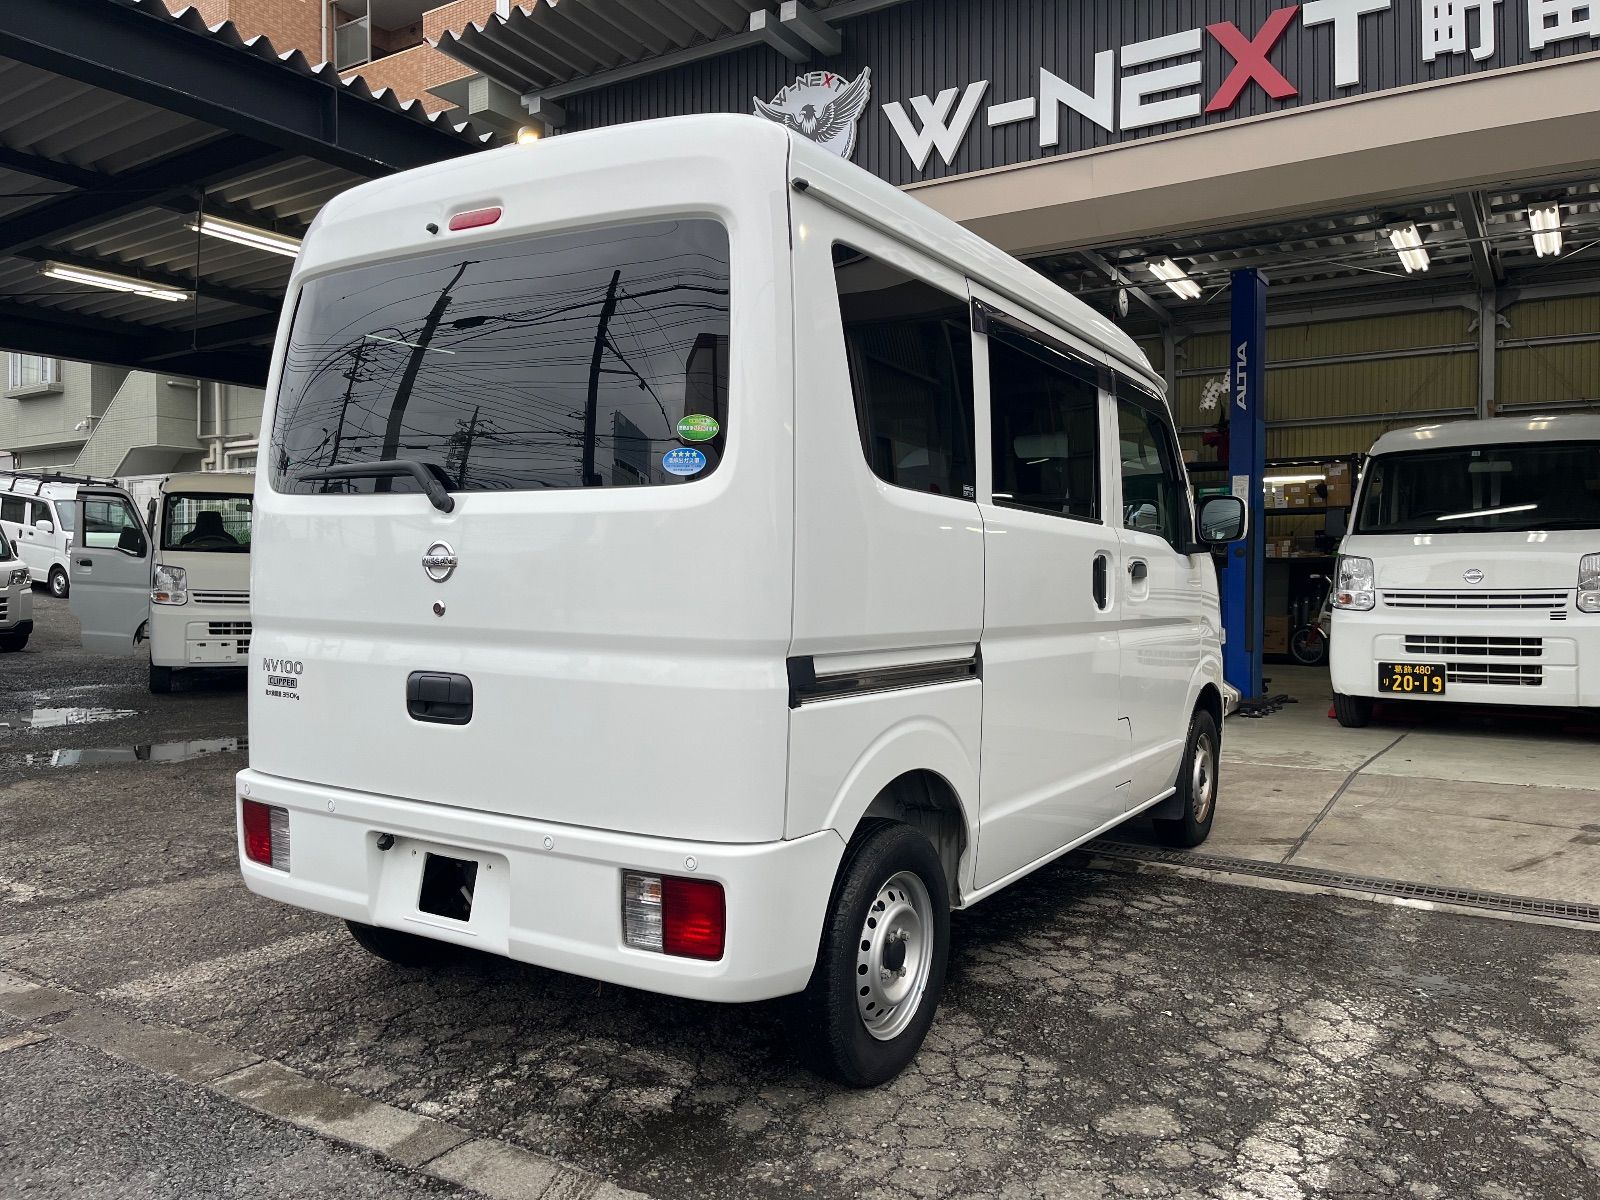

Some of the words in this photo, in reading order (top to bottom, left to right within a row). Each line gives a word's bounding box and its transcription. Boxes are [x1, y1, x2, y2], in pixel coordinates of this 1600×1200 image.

[771, 72, 846, 106] W-NEXT
[881, 0, 1391, 172] W-NEXT
[263, 657, 304, 675] NV100
[1414, 665, 1431, 674] 480
[268, 675, 297, 688] CLIPPER
[1392, 674, 1442, 692] 20-19
